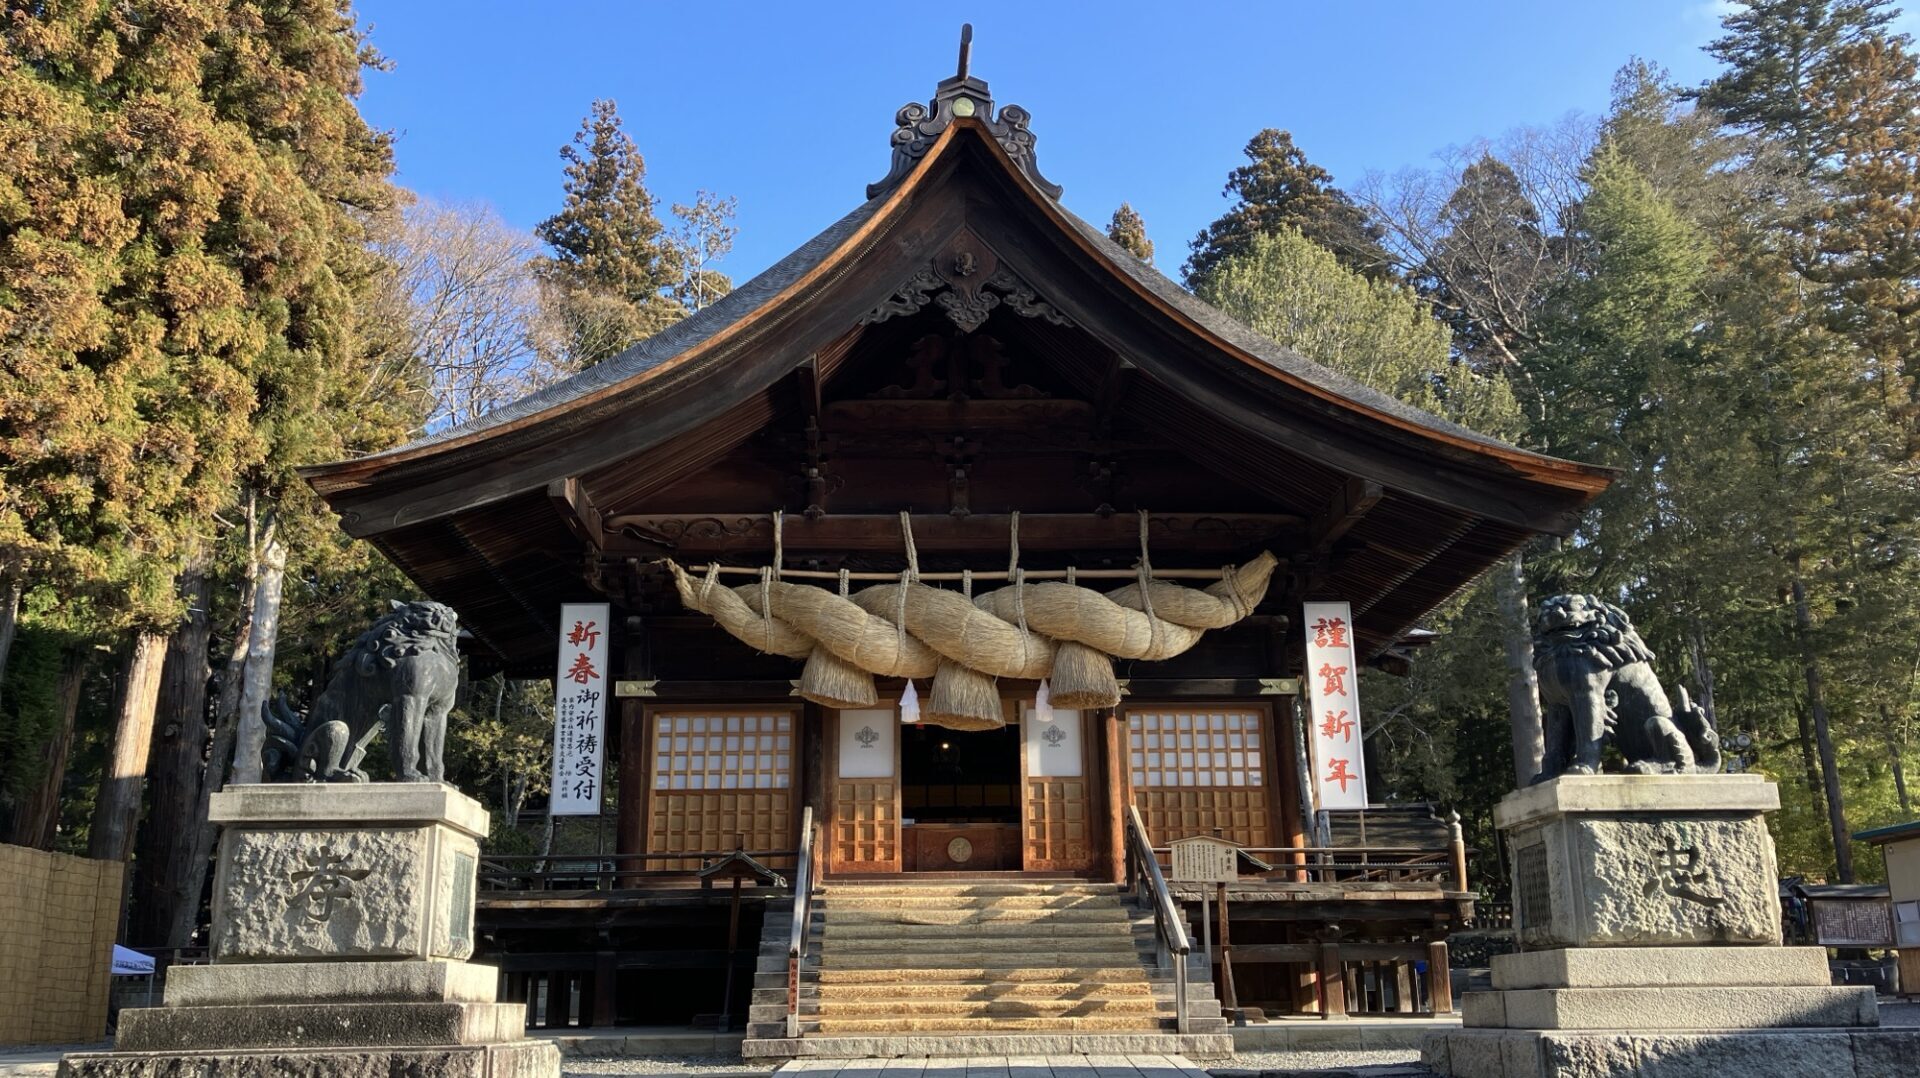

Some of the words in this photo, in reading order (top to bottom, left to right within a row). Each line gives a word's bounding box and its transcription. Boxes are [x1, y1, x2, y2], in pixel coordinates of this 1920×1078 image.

[1311, 617, 1358, 794] 謹賀新年
[285, 845, 372, 922] 孝
[1642, 836, 1725, 907] 忠
